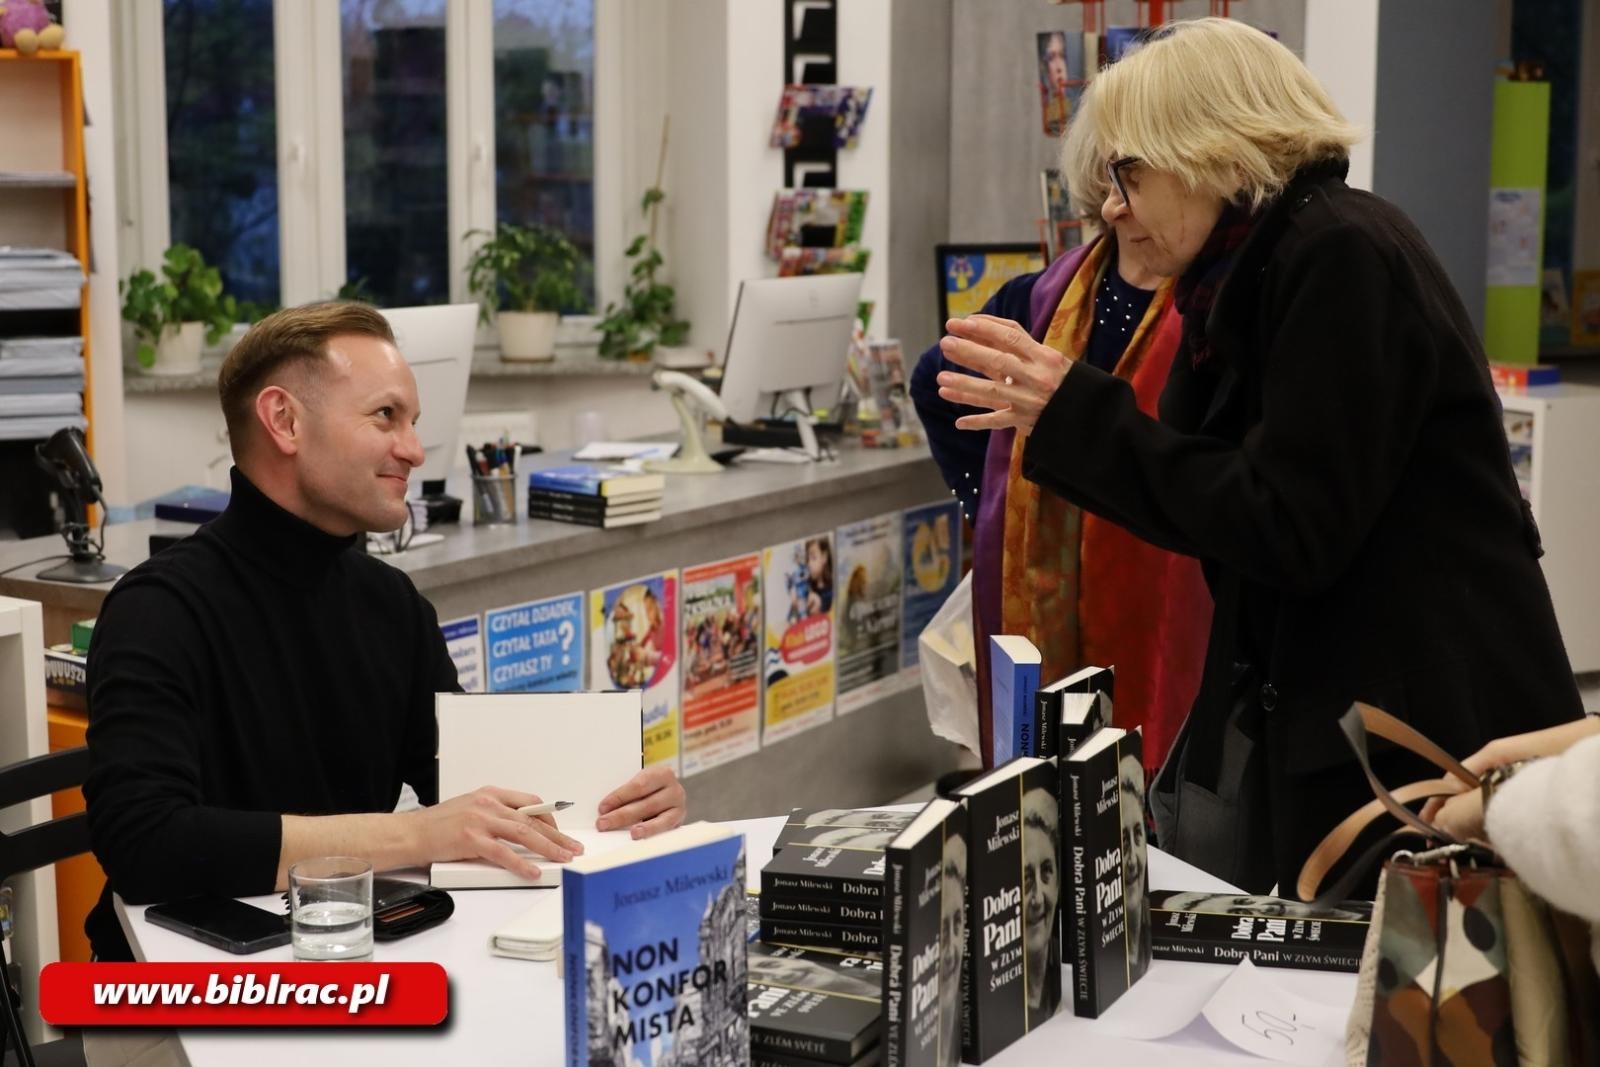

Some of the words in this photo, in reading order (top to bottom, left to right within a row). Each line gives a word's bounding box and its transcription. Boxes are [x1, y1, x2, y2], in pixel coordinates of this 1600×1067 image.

[532, 629, 558, 649] TATA
[558, 620, 575, 666] ?
[494, 658, 538, 683] CZYTASZ
[540, 654, 552, 673] TY
[1070, 774, 1080, 800] Jonasz
[1101, 776, 1118, 798] Jonasz
[1096, 790, 1119, 816] Milewski
[994, 810, 1020, 835] Jonasz
[1072, 802, 1082, 837] Milewski
[986, 825, 1020, 854] Milewski
[1074, 846, 1086, 888] Dobra
[1095, 848, 1121, 880] Dobra
[665, 864, 730, 898] Milewski
[774, 878, 798, 888] Jonasz
[800, 879, 833, 890] Milewski
[842, 882, 879, 896] Dobra
[1096, 868, 1123, 914] Pani
[612, 886, 661, 911] Jonasz
[772, 902, 796, 912] Jonasz
[798, 903, 831, 914] Milewski
[840, 906, 877, 920] Dobra
[983, 886, 1021, 921] Dobra
[1074, 888, 1087, 915] Pani
[774, 926, 798, 936] Jonasz
[800, 928, 832, 938] Milewski
[842, 931, 878, 944] Dobra
[983, 907, 1022, 958] Pani
[1232, 916, 1254, 940] Dobra
[1256, 918, 1287, 942] Pani
[612, 937, 678, 978] NON
[1171, 944, 1204, 954] Milewski
[1214, 946, 1250, 960] Dobra
[1253, 948, 1280, 962] Pani
[1294, 954, 1322, 964] ZŁYM
[1324, 952, 1361, 967] ŚWIECI
[614, 960, 728, 1014] KONFOR
[990, 963, 1023, 992] ŚWIECIE
[614, 1004, 695, 1049] MISTA
